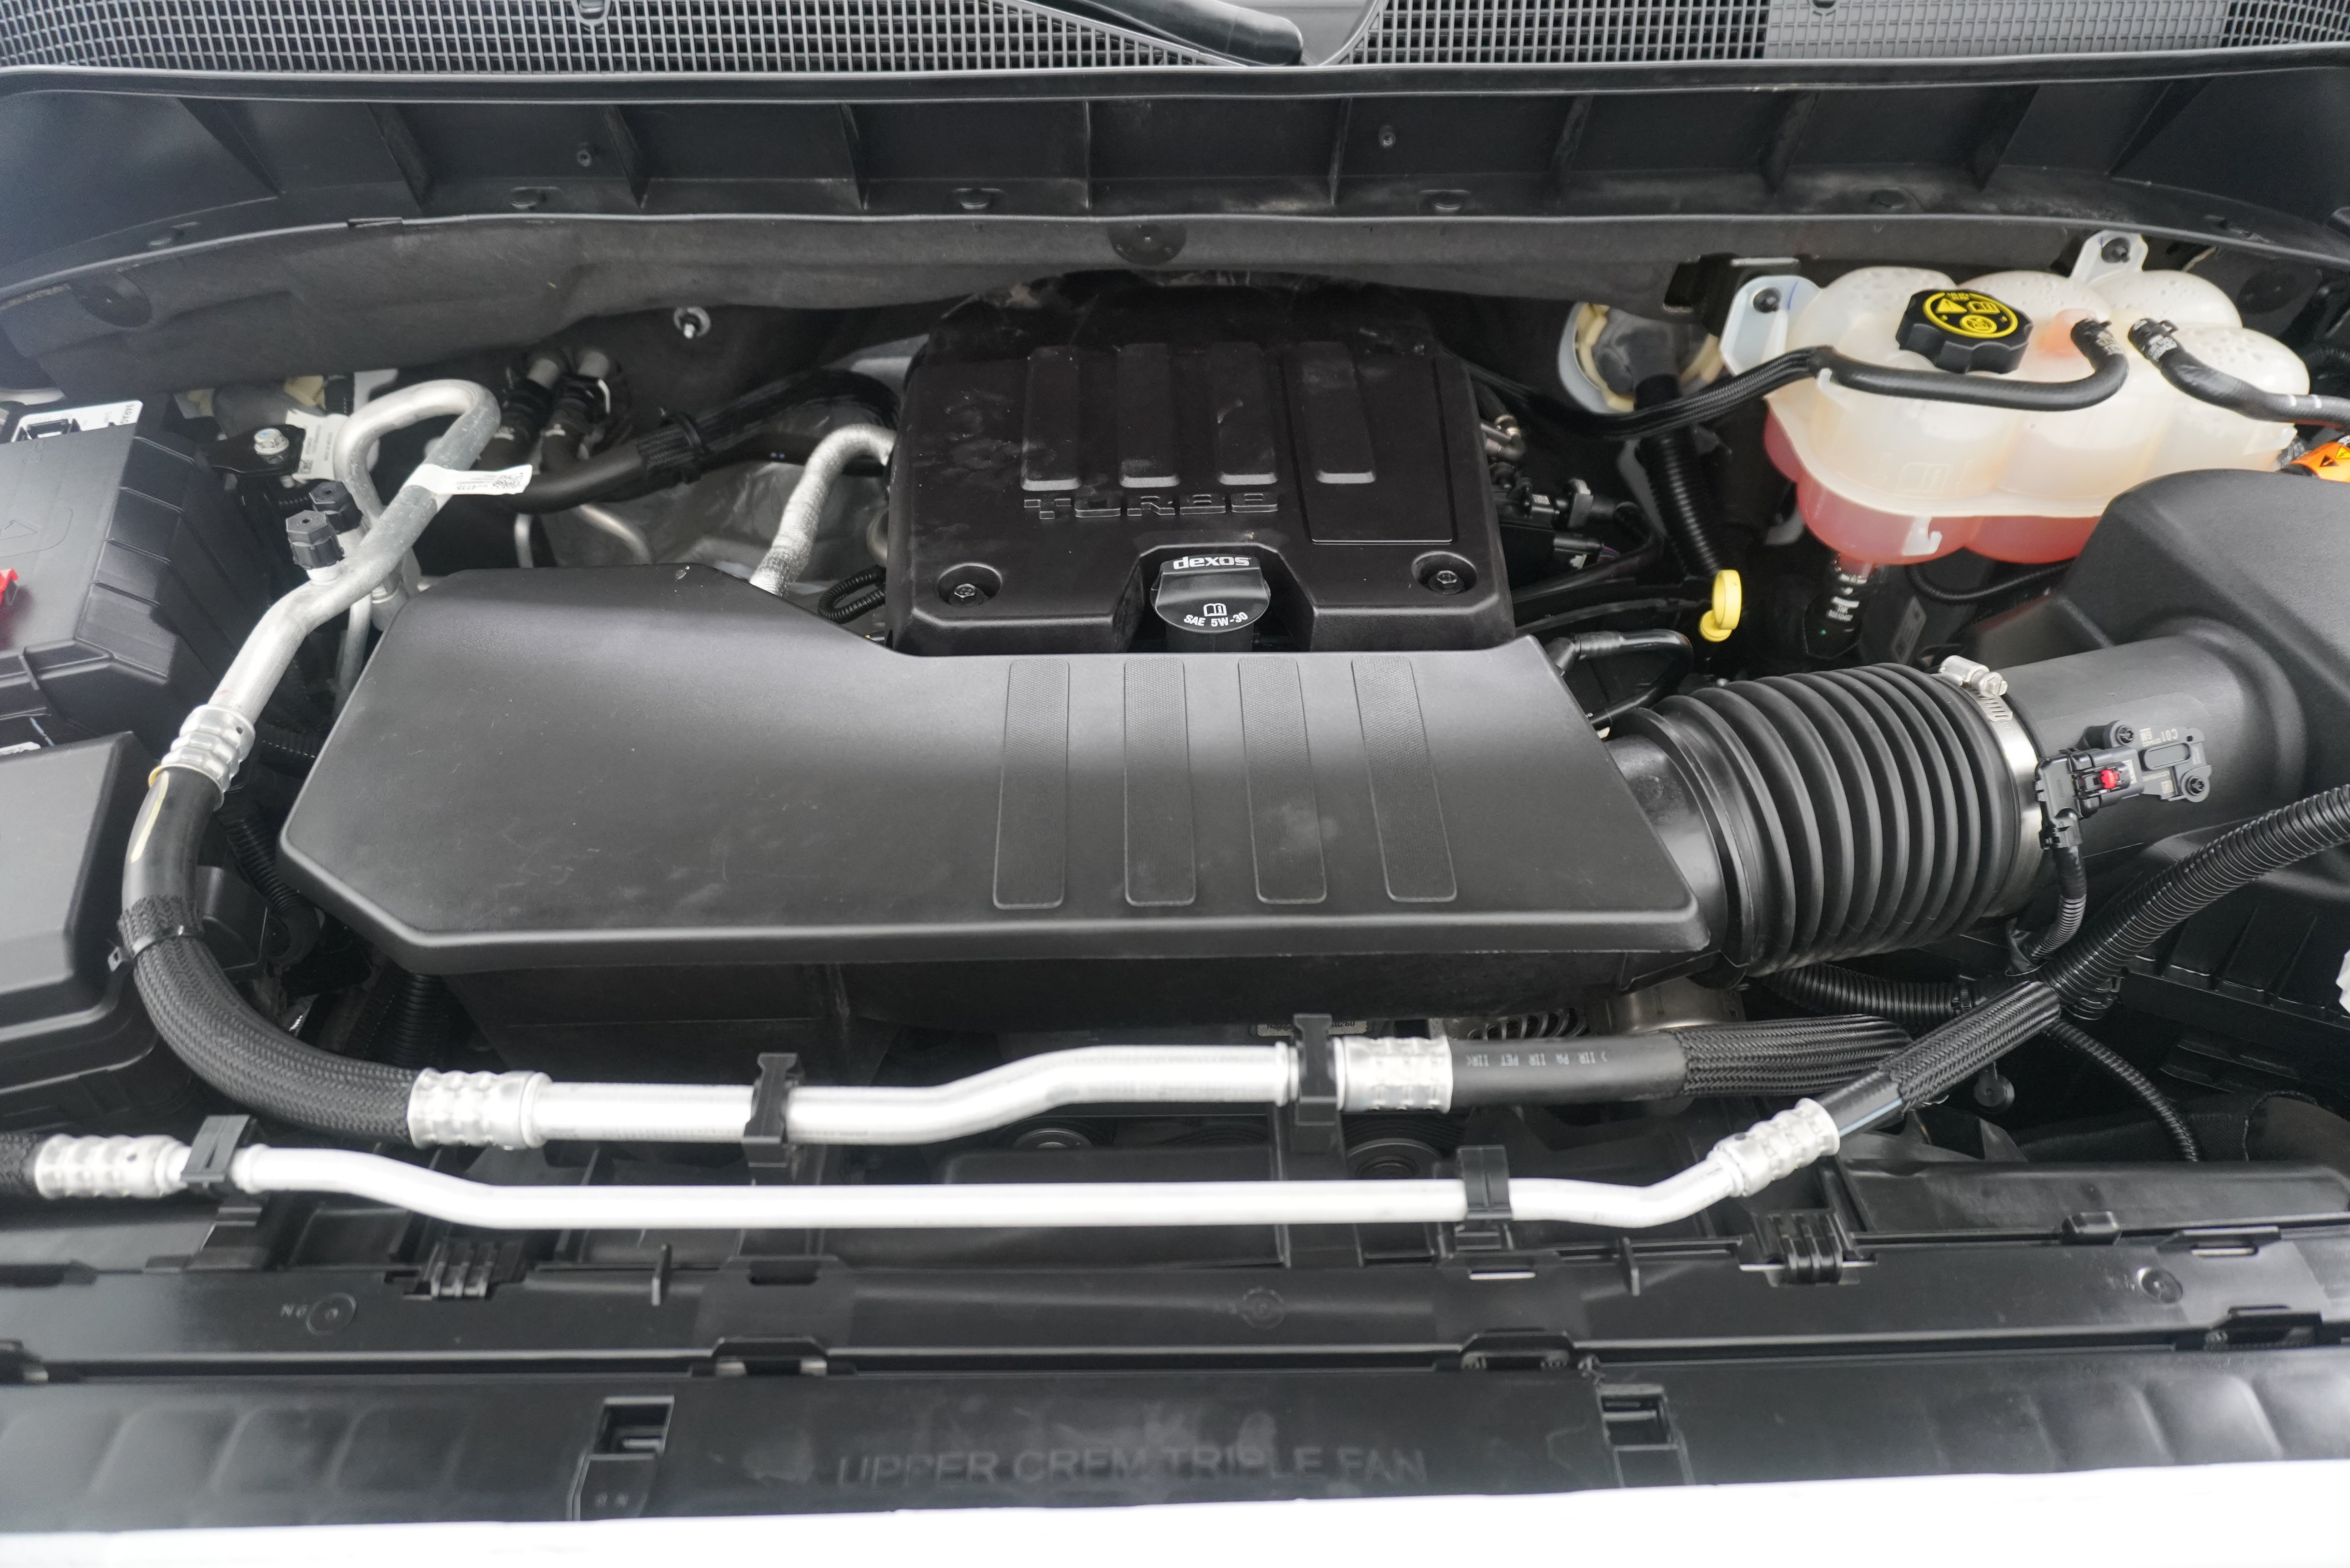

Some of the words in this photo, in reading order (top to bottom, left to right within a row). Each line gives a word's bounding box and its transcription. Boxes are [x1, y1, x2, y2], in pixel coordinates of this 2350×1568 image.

[1024, 492, 1278, 519] TURBO
[1173, 556, 1250, 569] dexos
[1184, 614, 1206, 626] SAE
[1211, 612, 1248, 627] 5W-30
[837, 1450, 1000, 1488] UPPER
[1336, 1447, 1428, 1484] FAN
